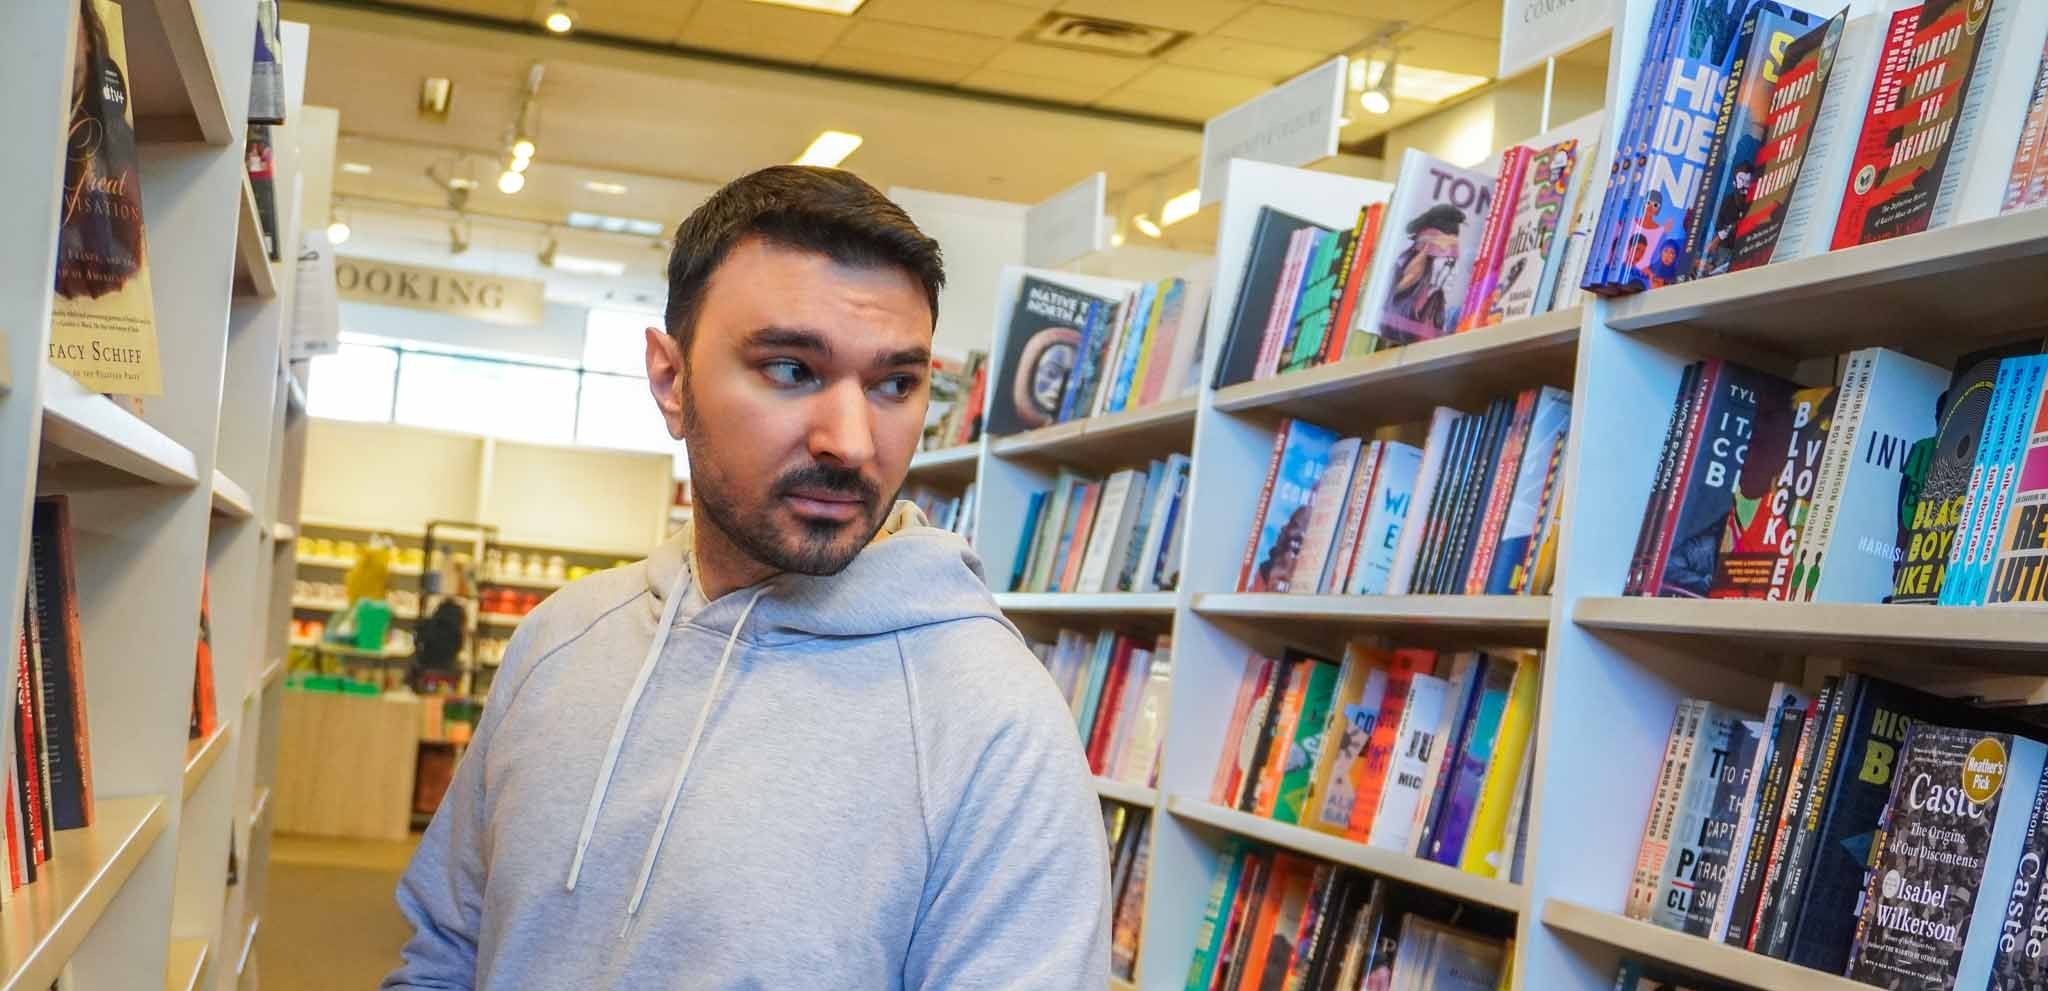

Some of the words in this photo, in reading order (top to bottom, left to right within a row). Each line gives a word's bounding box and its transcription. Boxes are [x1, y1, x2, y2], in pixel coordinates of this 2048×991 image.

[1892, 18, 1909, 43] THE
[1897, 15, 1920, 72] STAMPED
[1907, 23, 1963, 73] STAMPED
[1715, 59, 1744, 135] STAMPED
[1873, 48, 1901, 115] BEGINNING
[1885, 79, 1902, 113] FROM
[1911, 61, 1947, 99] FROM
[1918, 92, 1944, 126] THE
[1507, 220, 1549, 258] ultish
[336, 263, 504, 309] OOKING
[48, 343, 85, 360] TACY
[92, 340, 142, 364] SCHIFF
[1839, 371, 1857, 420] INVISIBLE
[1851, 371, 1869, 421] INVISIBLE
[1674, 399, 1690, 435] WOKE
[1843, 426, 1856, 446] BOY
[1659, 440, 1679, 490] RACISM
[1829, 450, 1849, 501] HARRISON
[1970, 468, 1983, 490] talk
[1984, 467, 1999, 492] talk
[2000, 466, 2016, 491] talk
[1816, 505, 1834, 547] MOONEY
[1958, 494, 1976, 532] about
[1972, 496, 1991, 533] about
[1988, 495, 2007, 533] about
[1907, 530, 1953, 562] BOY
[1815, 686, 1830, 711] THE
[1821, 714, 1847, 794] HISTORICALLY
[1967, 756, 2004, 775] Heather's
[1786, 781, 1804, 817] ACHE
[1972, 774, 1991, 790] Pick
[1705, 820, 1738, 842] CAPT
[1804, 795, 1823, 831] BLACK
[1911, 822, 1928, 837] The
[1928, 826, 1966, 850] Origins
[1889, 840, 1902, 854] of
[1901, 842, 1919, 858] Our
[1920, 844, 1979, 869] Discontents
[1897, 877, 1949, 909] Isabel
[1999, 852, 2041, 954] Caste
[1876, 904, 1957, 943] Wilkerson
